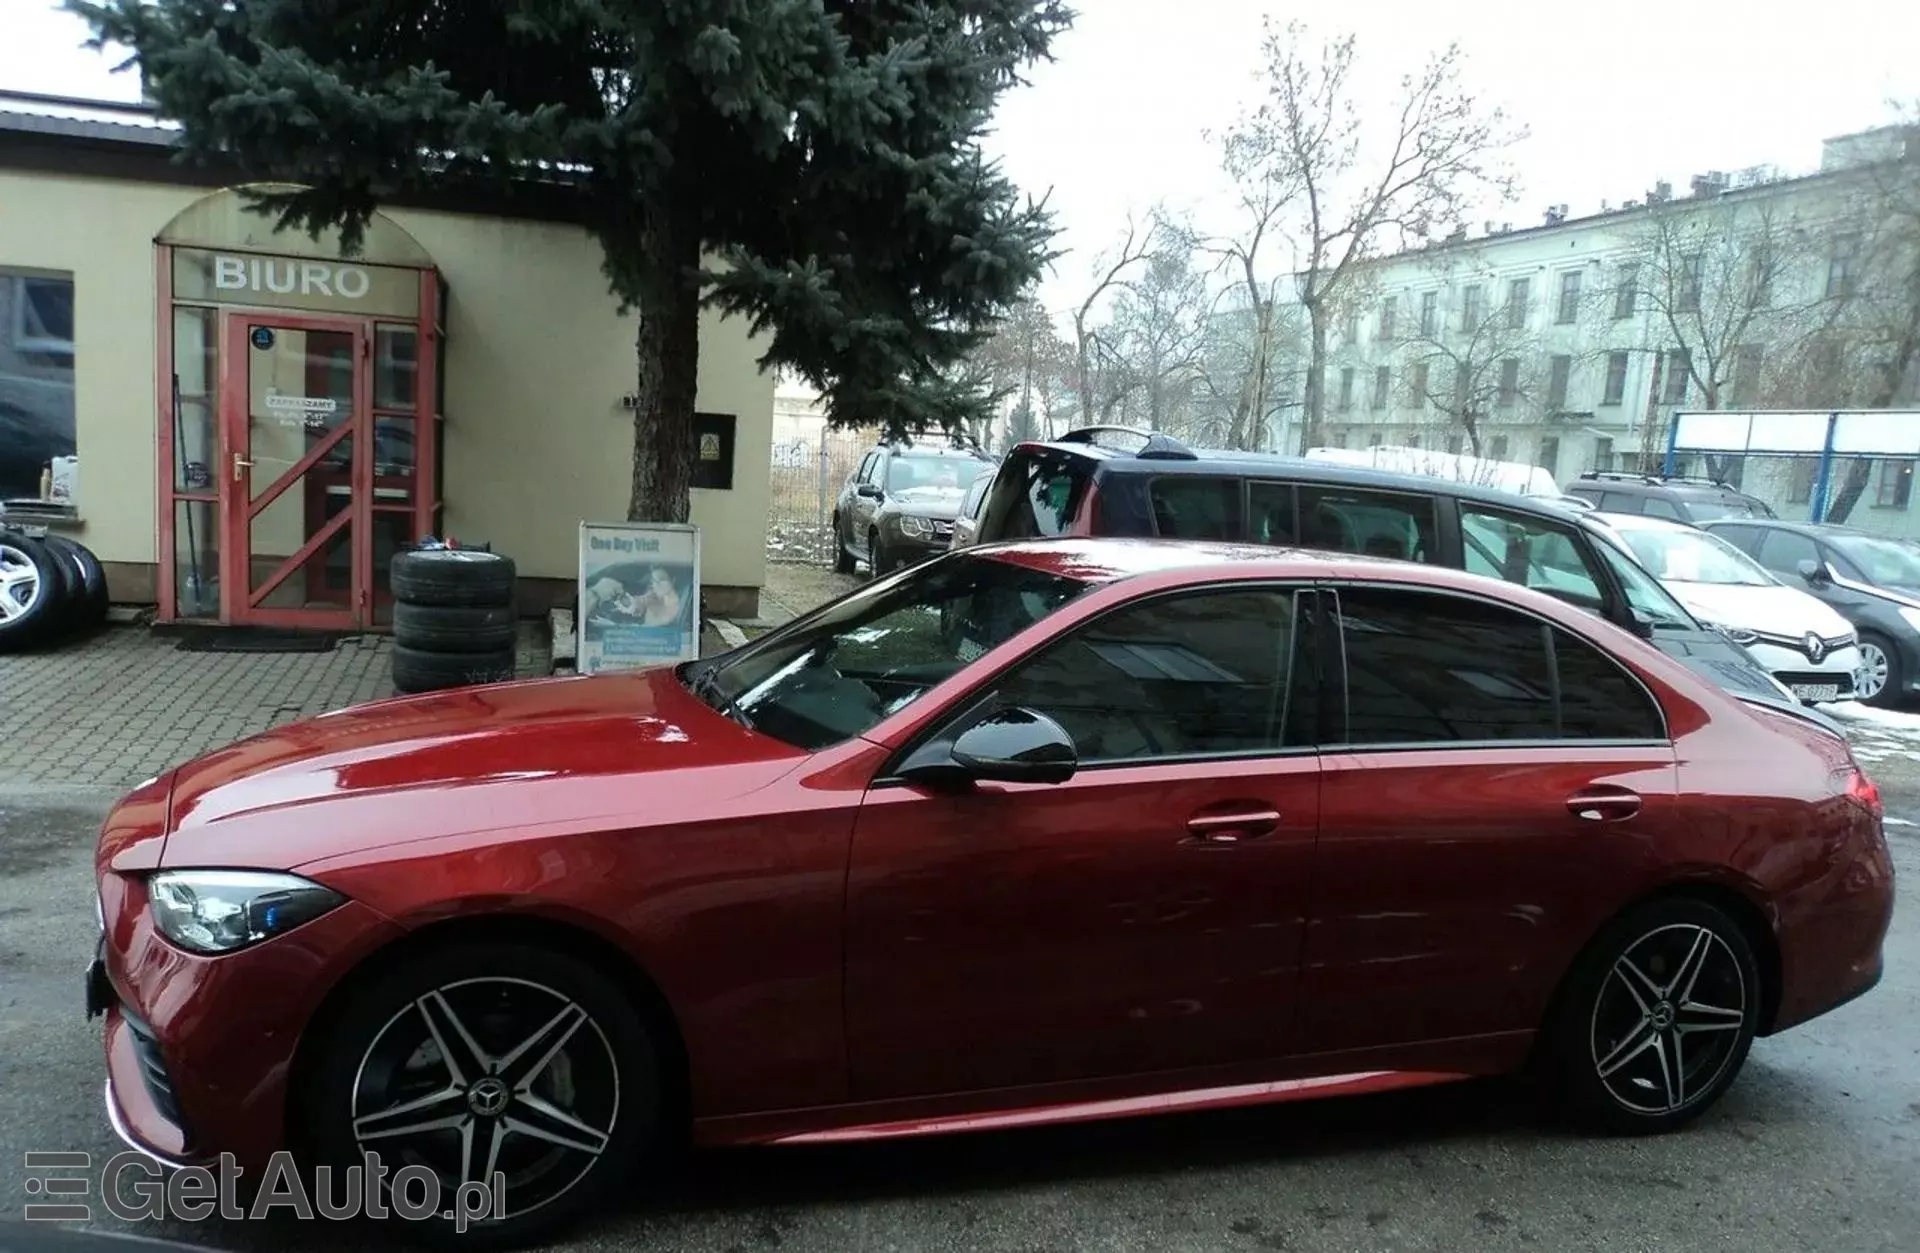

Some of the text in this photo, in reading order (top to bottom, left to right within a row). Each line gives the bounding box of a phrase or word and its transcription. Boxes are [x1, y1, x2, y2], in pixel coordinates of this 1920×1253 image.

[215, 255, 370, 298] BIURO
[590, 536, 612, 550] One
[613, 537, 633, 553] Day
